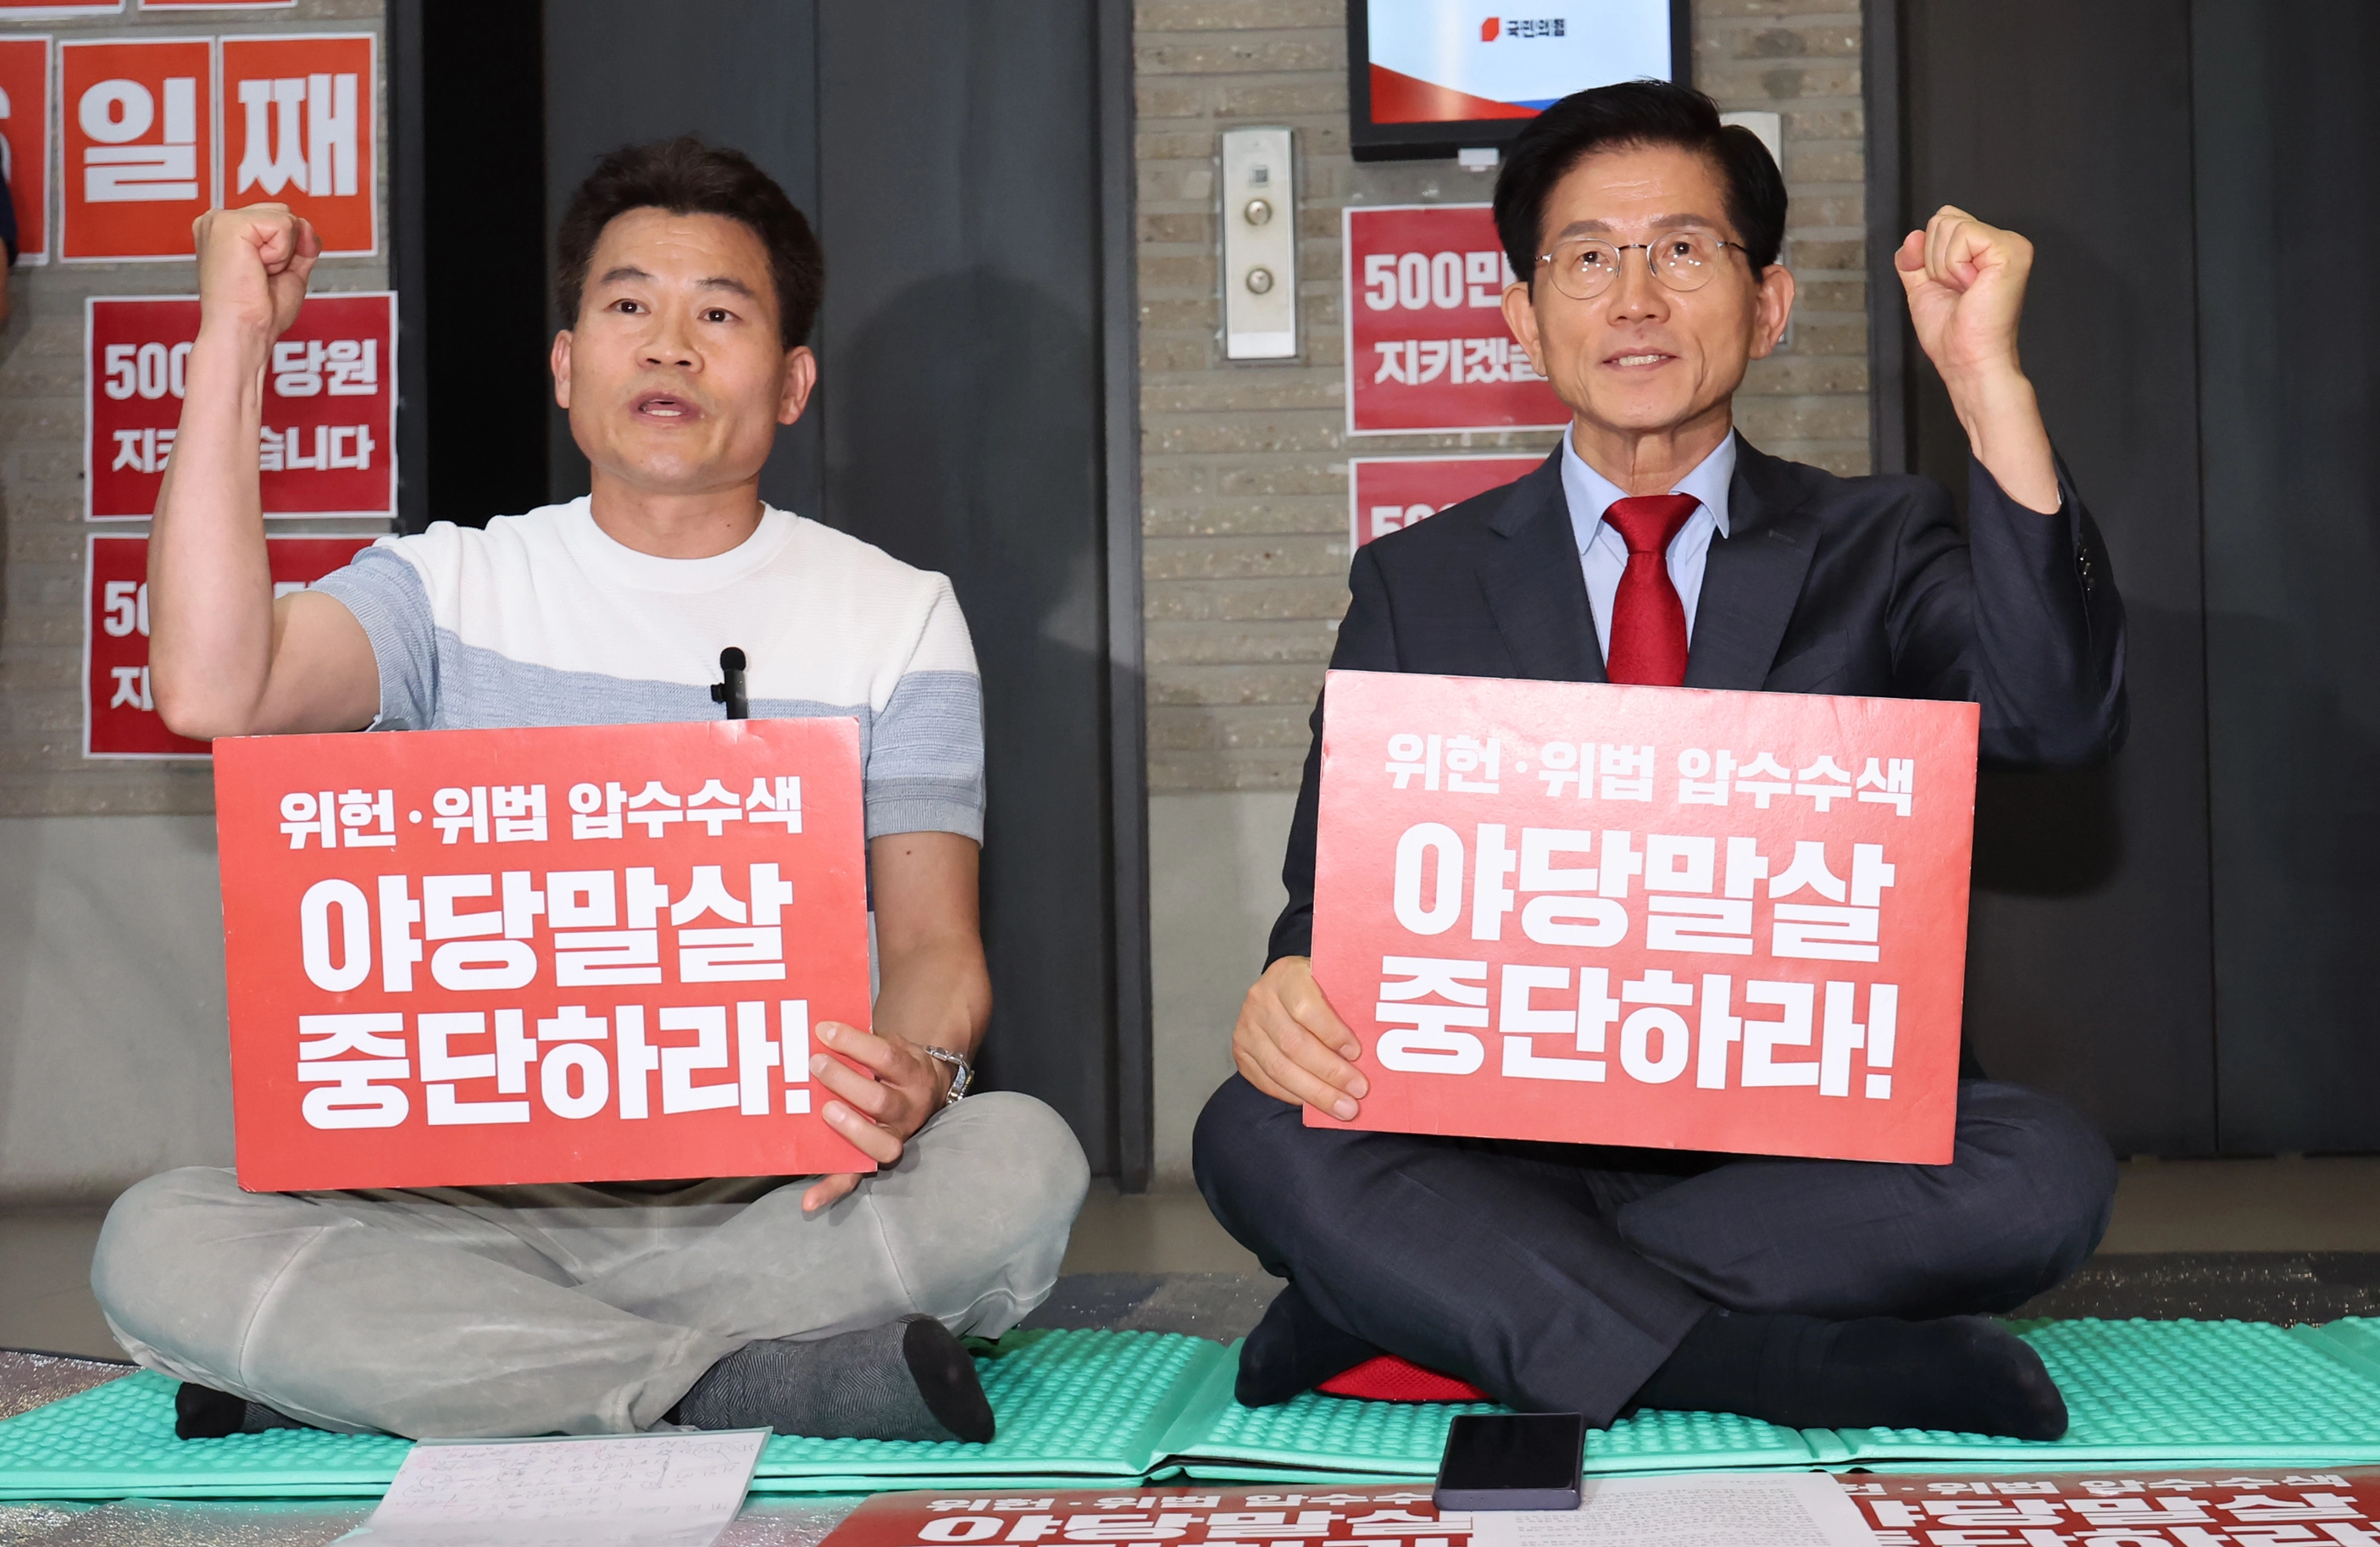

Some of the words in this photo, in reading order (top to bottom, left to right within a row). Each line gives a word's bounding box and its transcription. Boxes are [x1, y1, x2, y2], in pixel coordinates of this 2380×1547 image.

[1507, 19, 1565, 38] 국민의힘
[0, 74, 358, 202] 일째
[104, 341, 195, 400] 500
[272, 339, 378, 396] 당원
[112, 424, 375, 473] 지습니다
[1384, 734, 1655, 801] 위헌·위법
[1677, 747, 1915, 817] 압수수색
[280, 784, 548, 849] 위헌·위법
[568, 776, 802, 840] 압수수색
[300, 862, 794, 993] 야당말살
[1394, 822, 1895, 962] 야당말살
[1375, 955, 1899, 1100] 중단하라!
[297, 999, 811, 1130] 중단하라!
[1245, 1492, 1434, 1507] 압수수
[1838, 1481, 2061, 1495] 헌·위법
[2078, 1474, 2352, 1496] 압수수색
[918, 1509, 1473, 1542] 야당말살
